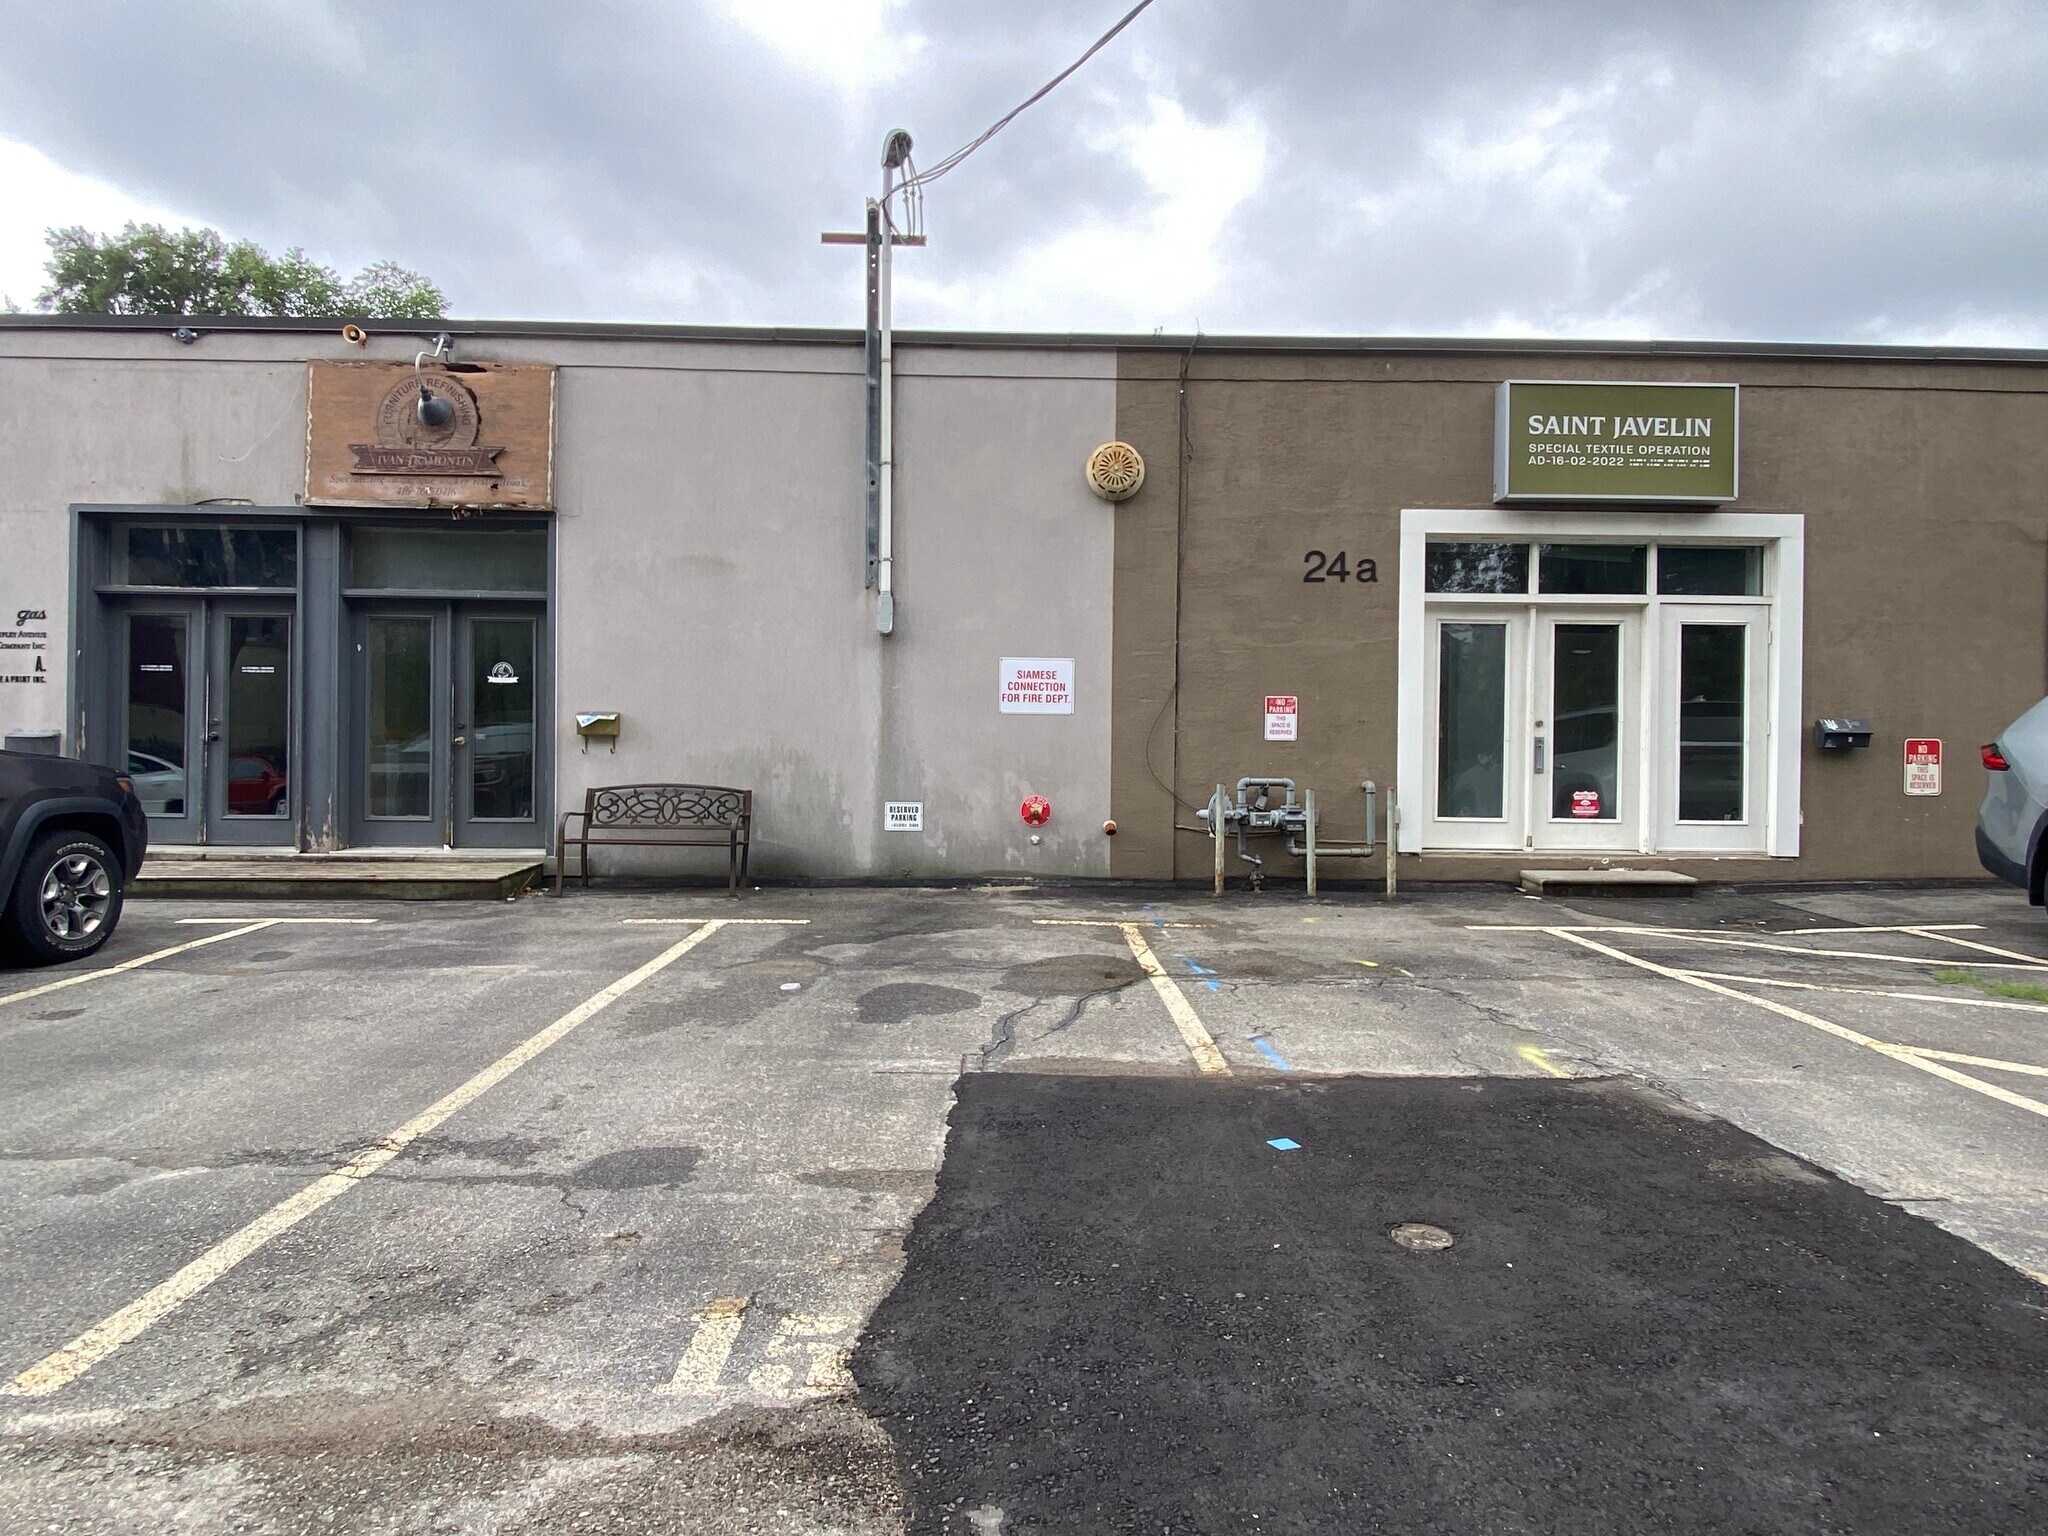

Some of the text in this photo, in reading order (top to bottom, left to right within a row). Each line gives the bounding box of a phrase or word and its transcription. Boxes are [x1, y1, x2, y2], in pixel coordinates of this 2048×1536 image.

[1528, 415, 1712, 439] SAINT JAVELIN
[1528, 443, 1711, 456] SPECIAL TEXTILE OPERATION
[1528, 456, 1625, 467] AD-16-02-2022
[1303, 550, 1378, 583] 24a
[16, 609, 47, 627] gas
[1017, 670, 1057, 680] SIAMESE
[1007, 681, 1066, 692] CONNECTION
[1001, 693, 1071, 703] FOR FIRE DEPT.
[1275, 698, 1286, 706] NO
[1269, 705, 1295, 713] PARKING
[1917, 744, 1928, 753] NO
[1908, 754, 1938, 763] PARKING
